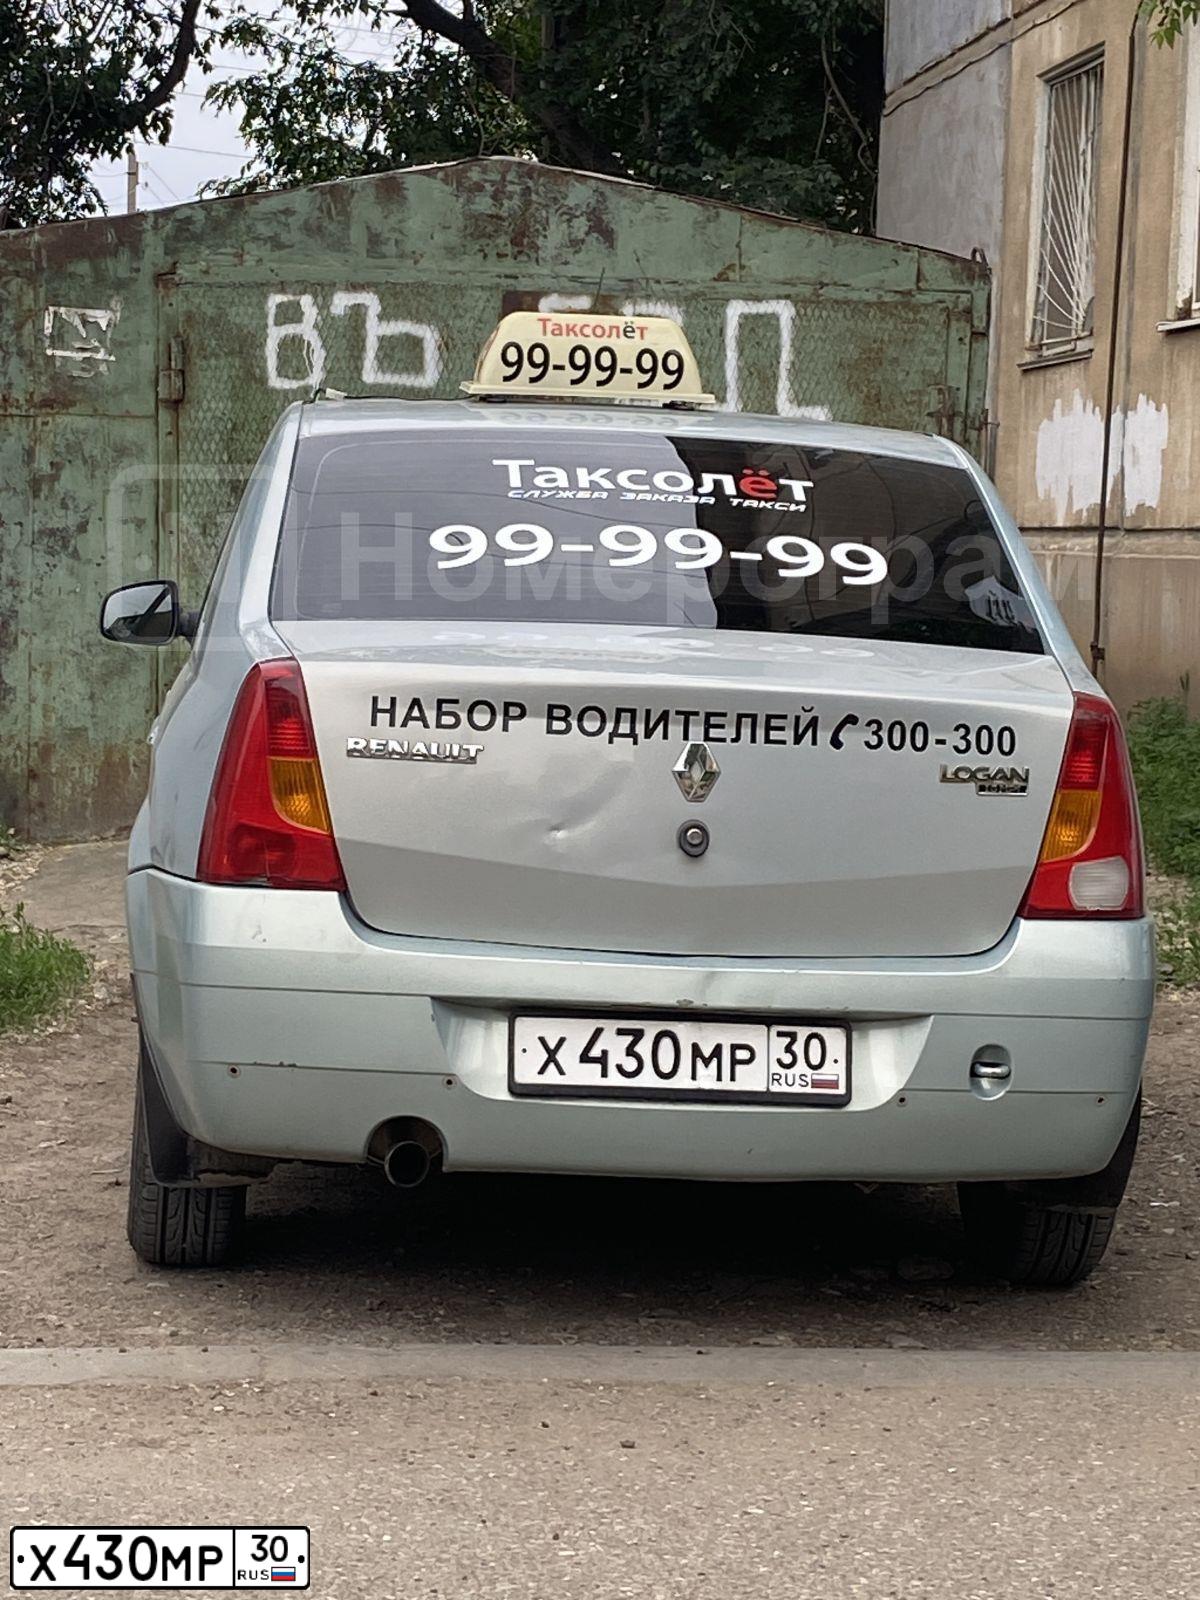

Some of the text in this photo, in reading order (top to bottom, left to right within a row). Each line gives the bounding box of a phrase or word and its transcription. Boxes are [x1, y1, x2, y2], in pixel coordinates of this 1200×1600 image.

[537, 317, 649, 341] Таксолёт
[500, 341, 685, 391] 99-99-99
[491, 458, 815, 502] Таксолёт
[506, 489, 807, 513] СЛУЖБА ЗАКАЗА ТАКСИ
[429, 523, 889, 586] 99-99-99
[370, 695, 1017, 757] НАБОР ВОДИТЕЛЕЙ 300-300
[347, 736, 485, 765] RENAULT
[939, 763, 1030, 784] LOGAN
[776, 1030, 827, 1071] 30
[770, 1072, 810, 1088] RUS
